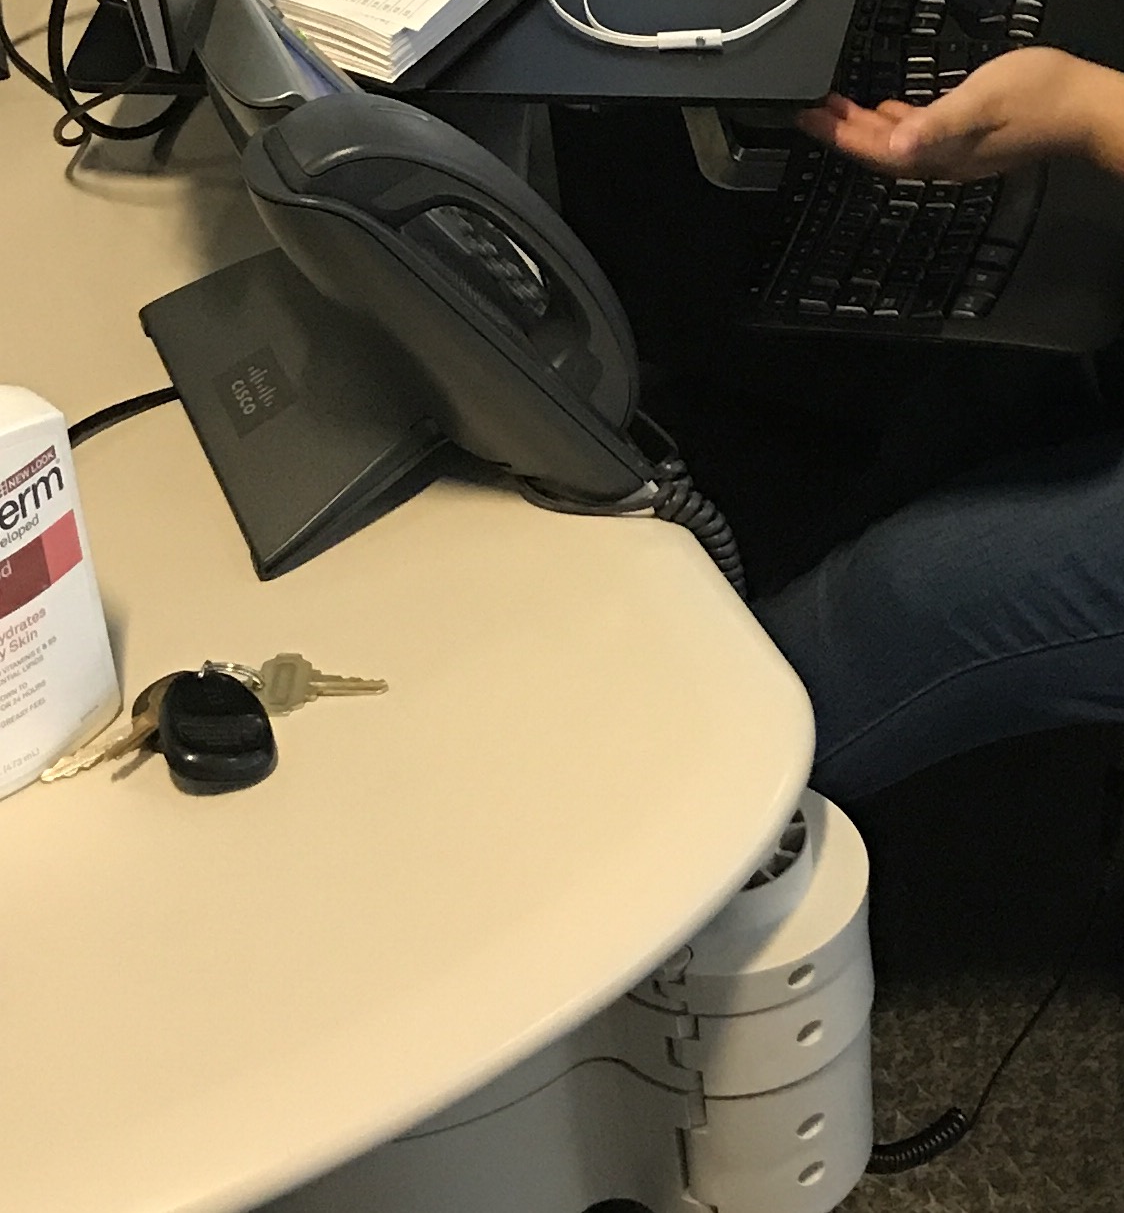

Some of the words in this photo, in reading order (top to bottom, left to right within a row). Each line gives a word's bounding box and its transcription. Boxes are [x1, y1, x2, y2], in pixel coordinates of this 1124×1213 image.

[231, 379, 256, 414] CISCO
[8, 470, 31, 489] NEW
[30, 451, 55, 473] LOOK
[0, 466, 64, 530] erm
[0, 513, 39, 548] eloped
[9, 630, 38, 653] Skin
